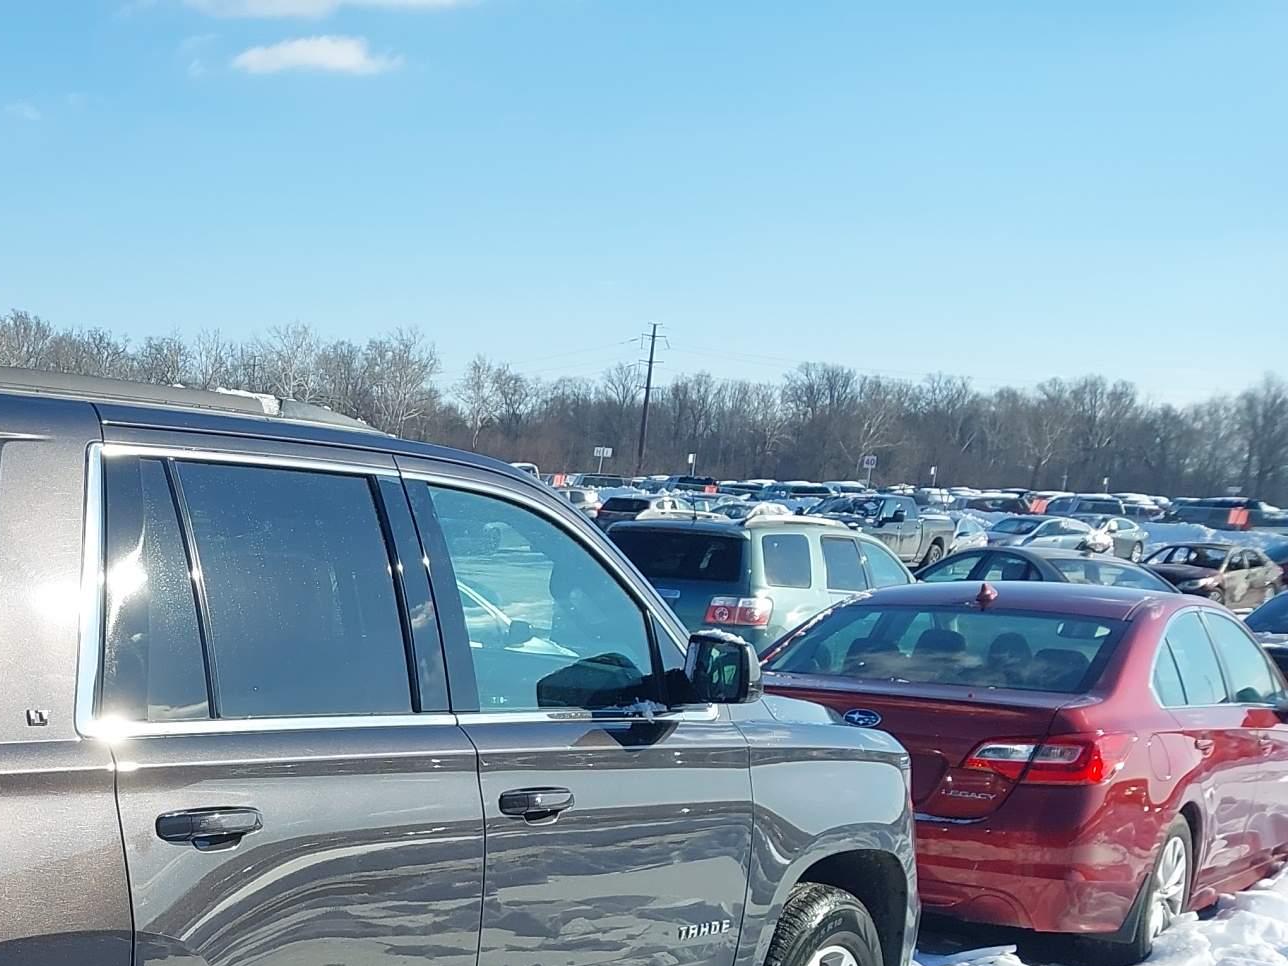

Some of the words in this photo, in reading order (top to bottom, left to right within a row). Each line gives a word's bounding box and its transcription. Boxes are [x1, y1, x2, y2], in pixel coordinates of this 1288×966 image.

[865, 458, 876, 466] 40
[941, 788, 997, 800] LEGACY
[678, 919, 731, 941] TAHOE
